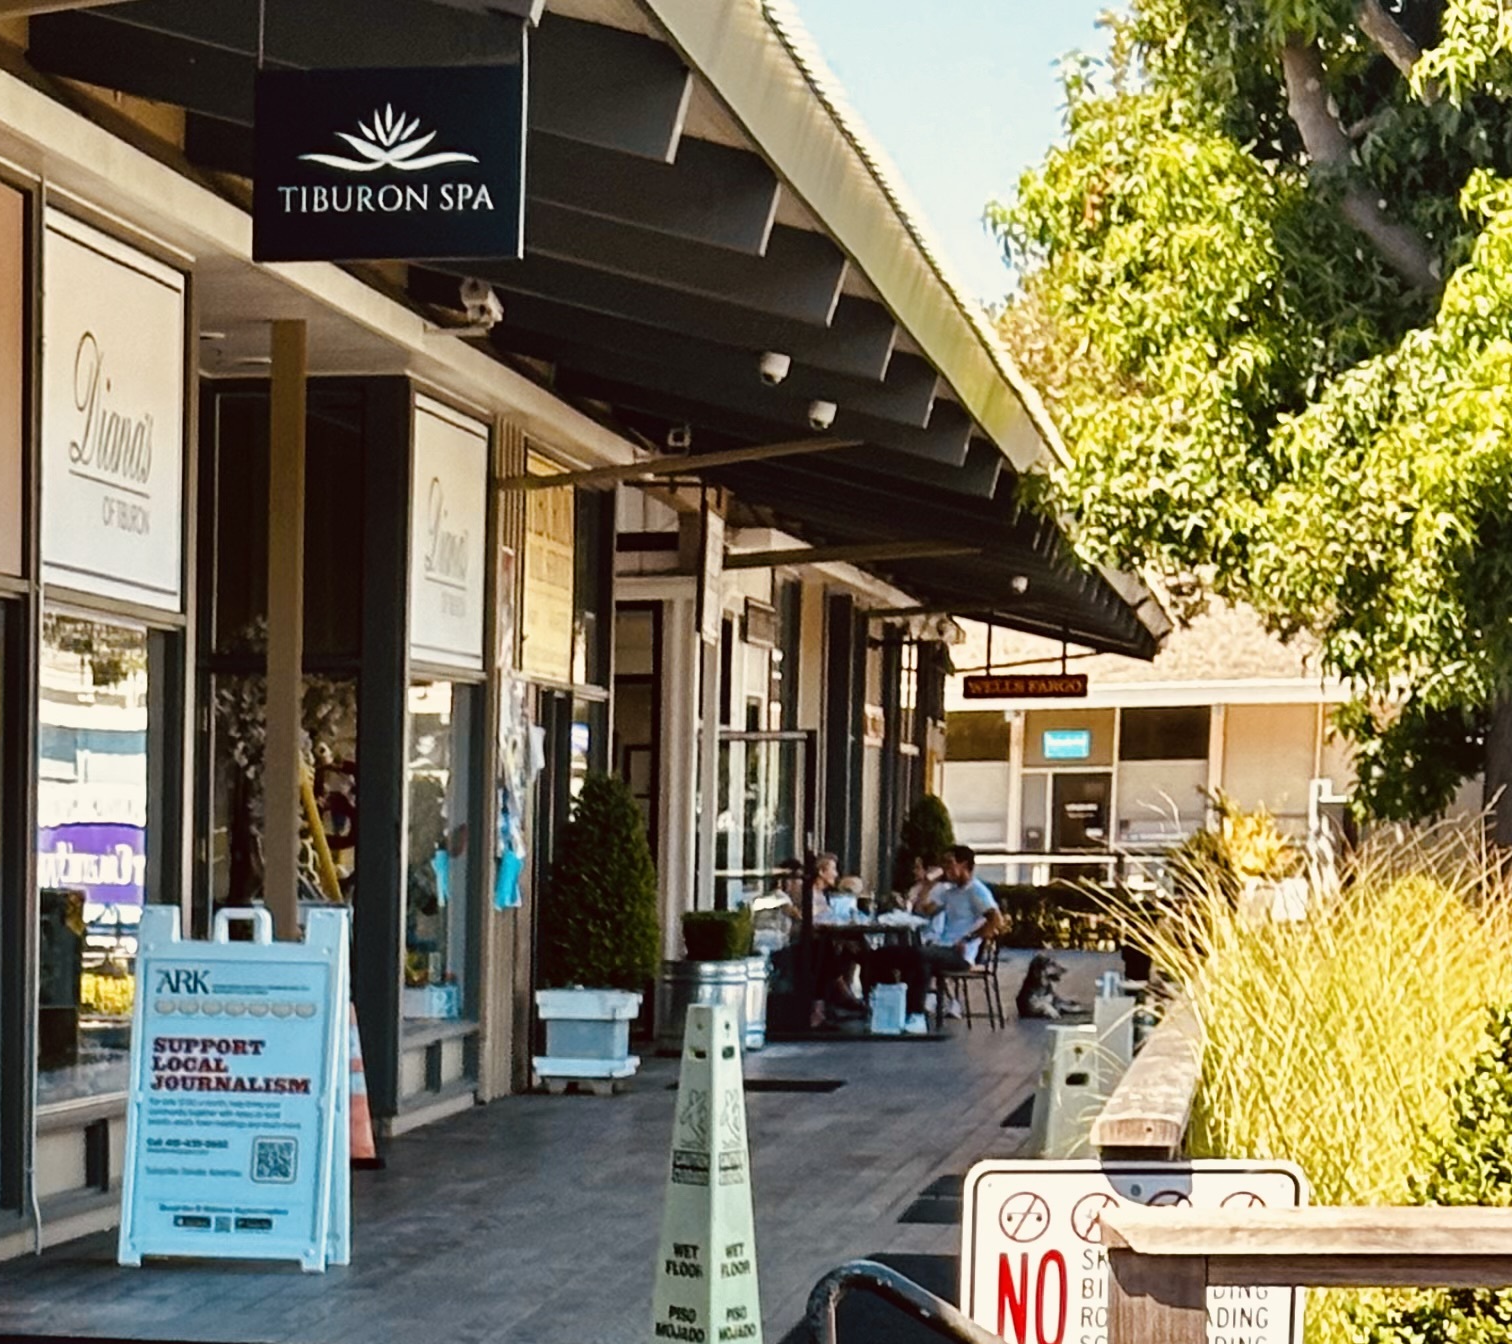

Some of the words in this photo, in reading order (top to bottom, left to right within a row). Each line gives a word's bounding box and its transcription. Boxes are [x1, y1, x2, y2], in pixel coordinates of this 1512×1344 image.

[277, 184, 430, 214] TIBURON
[440, 183, 495, 213] SPA
[68, 330, 154, 485] Diana's
[968, 679, 1025, 695] WELLS
[1028, 679, 1083, 694] FARGO
[154, 969, 212, 995] ARK
[152, 1036, 267, 1056] SUPPORT
[150, 1056, 229, 1074] LOCAL
[149, 1075, 312, 1096] JOURNALISM
[673, 1242, 700, 1260] WET
[725, 1242, 745, 1258] WET
[665, 1260, 703, 1279] FLOOR
[668, 1304, 697, 1325] PISO
[725, 1304, 748, 1322] PISO
[655, 1322, 706, 1343] MOJADO
[718, 1323, 757, 1342] MOJADO
